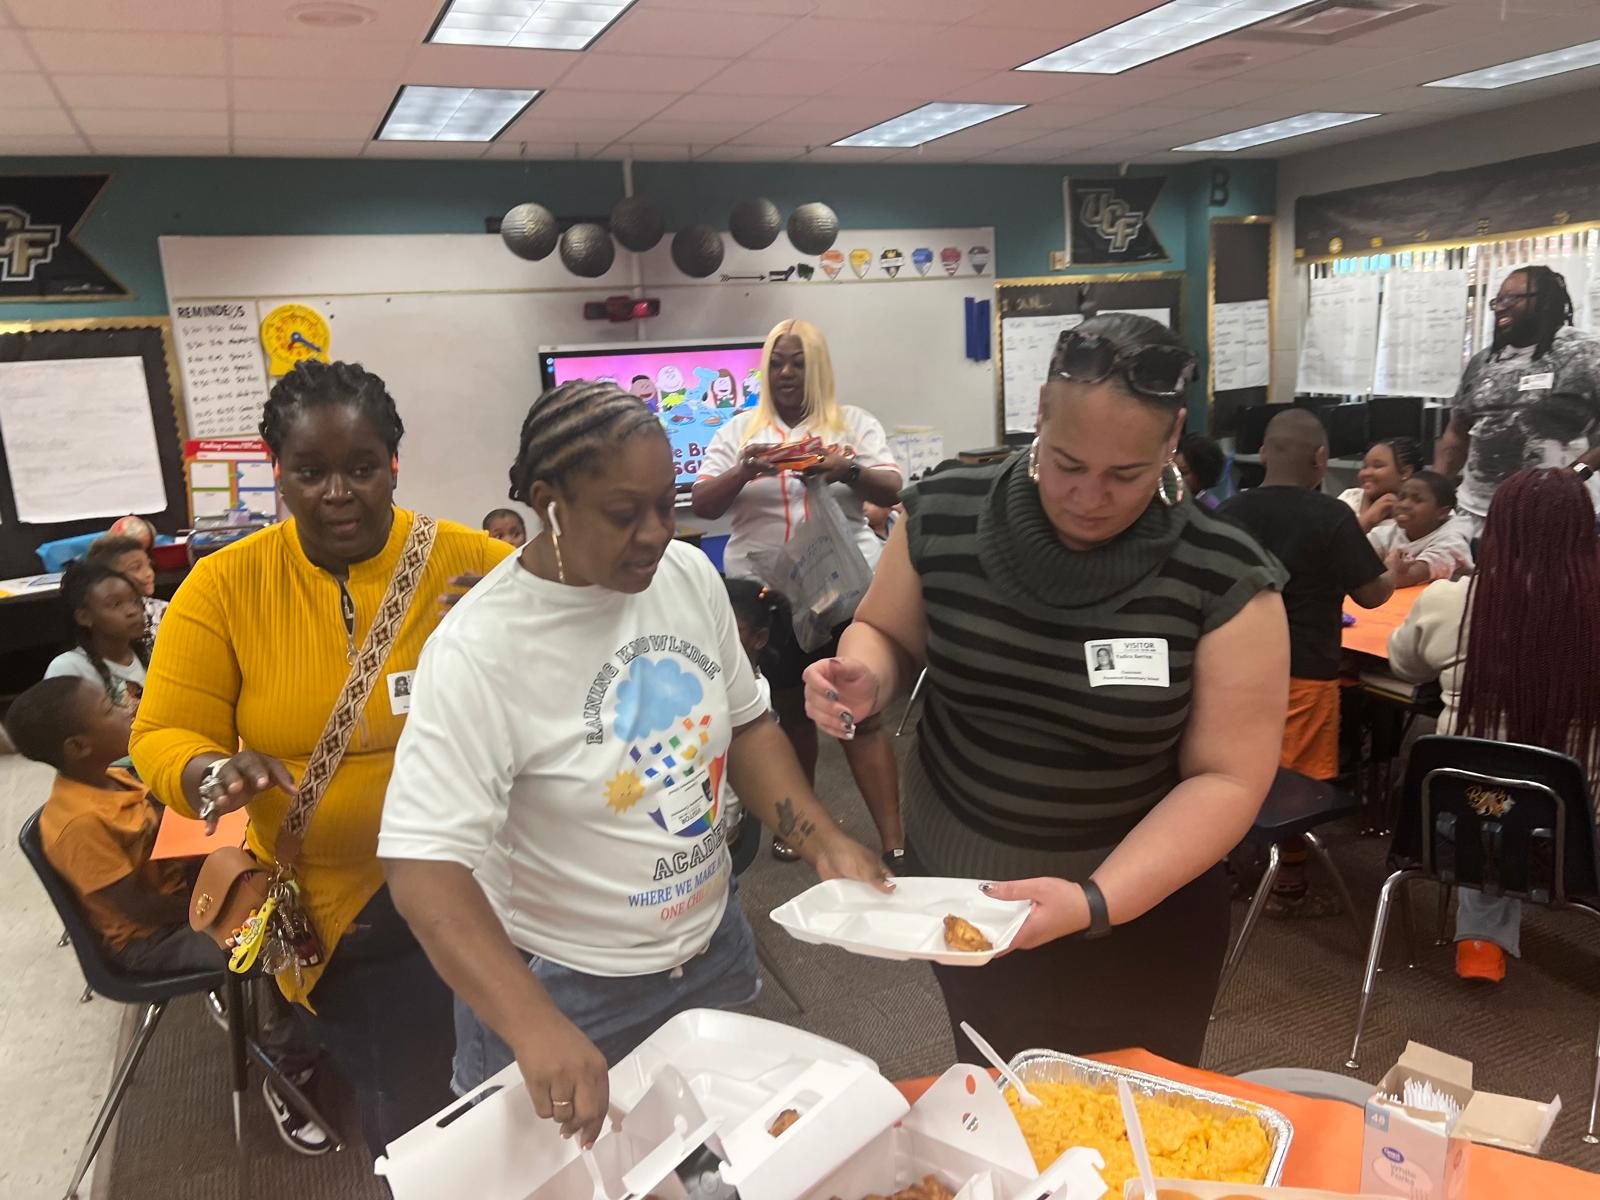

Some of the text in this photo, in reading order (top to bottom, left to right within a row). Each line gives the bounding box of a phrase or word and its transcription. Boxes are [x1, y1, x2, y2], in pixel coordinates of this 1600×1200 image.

[1078, 189, 1142, 252] UCF
[689, 443, 707, 457] Br
[584, 634, 721, 745] RAINING KNOWLEDGE
[653, 818, 725, 881] ACADE
[628, 886, 673, 908] WHERE
[675, 879, 693, 897] WE
[695, 860, 717, 888] MAKE
[660, 902, 686, 921] ONE
